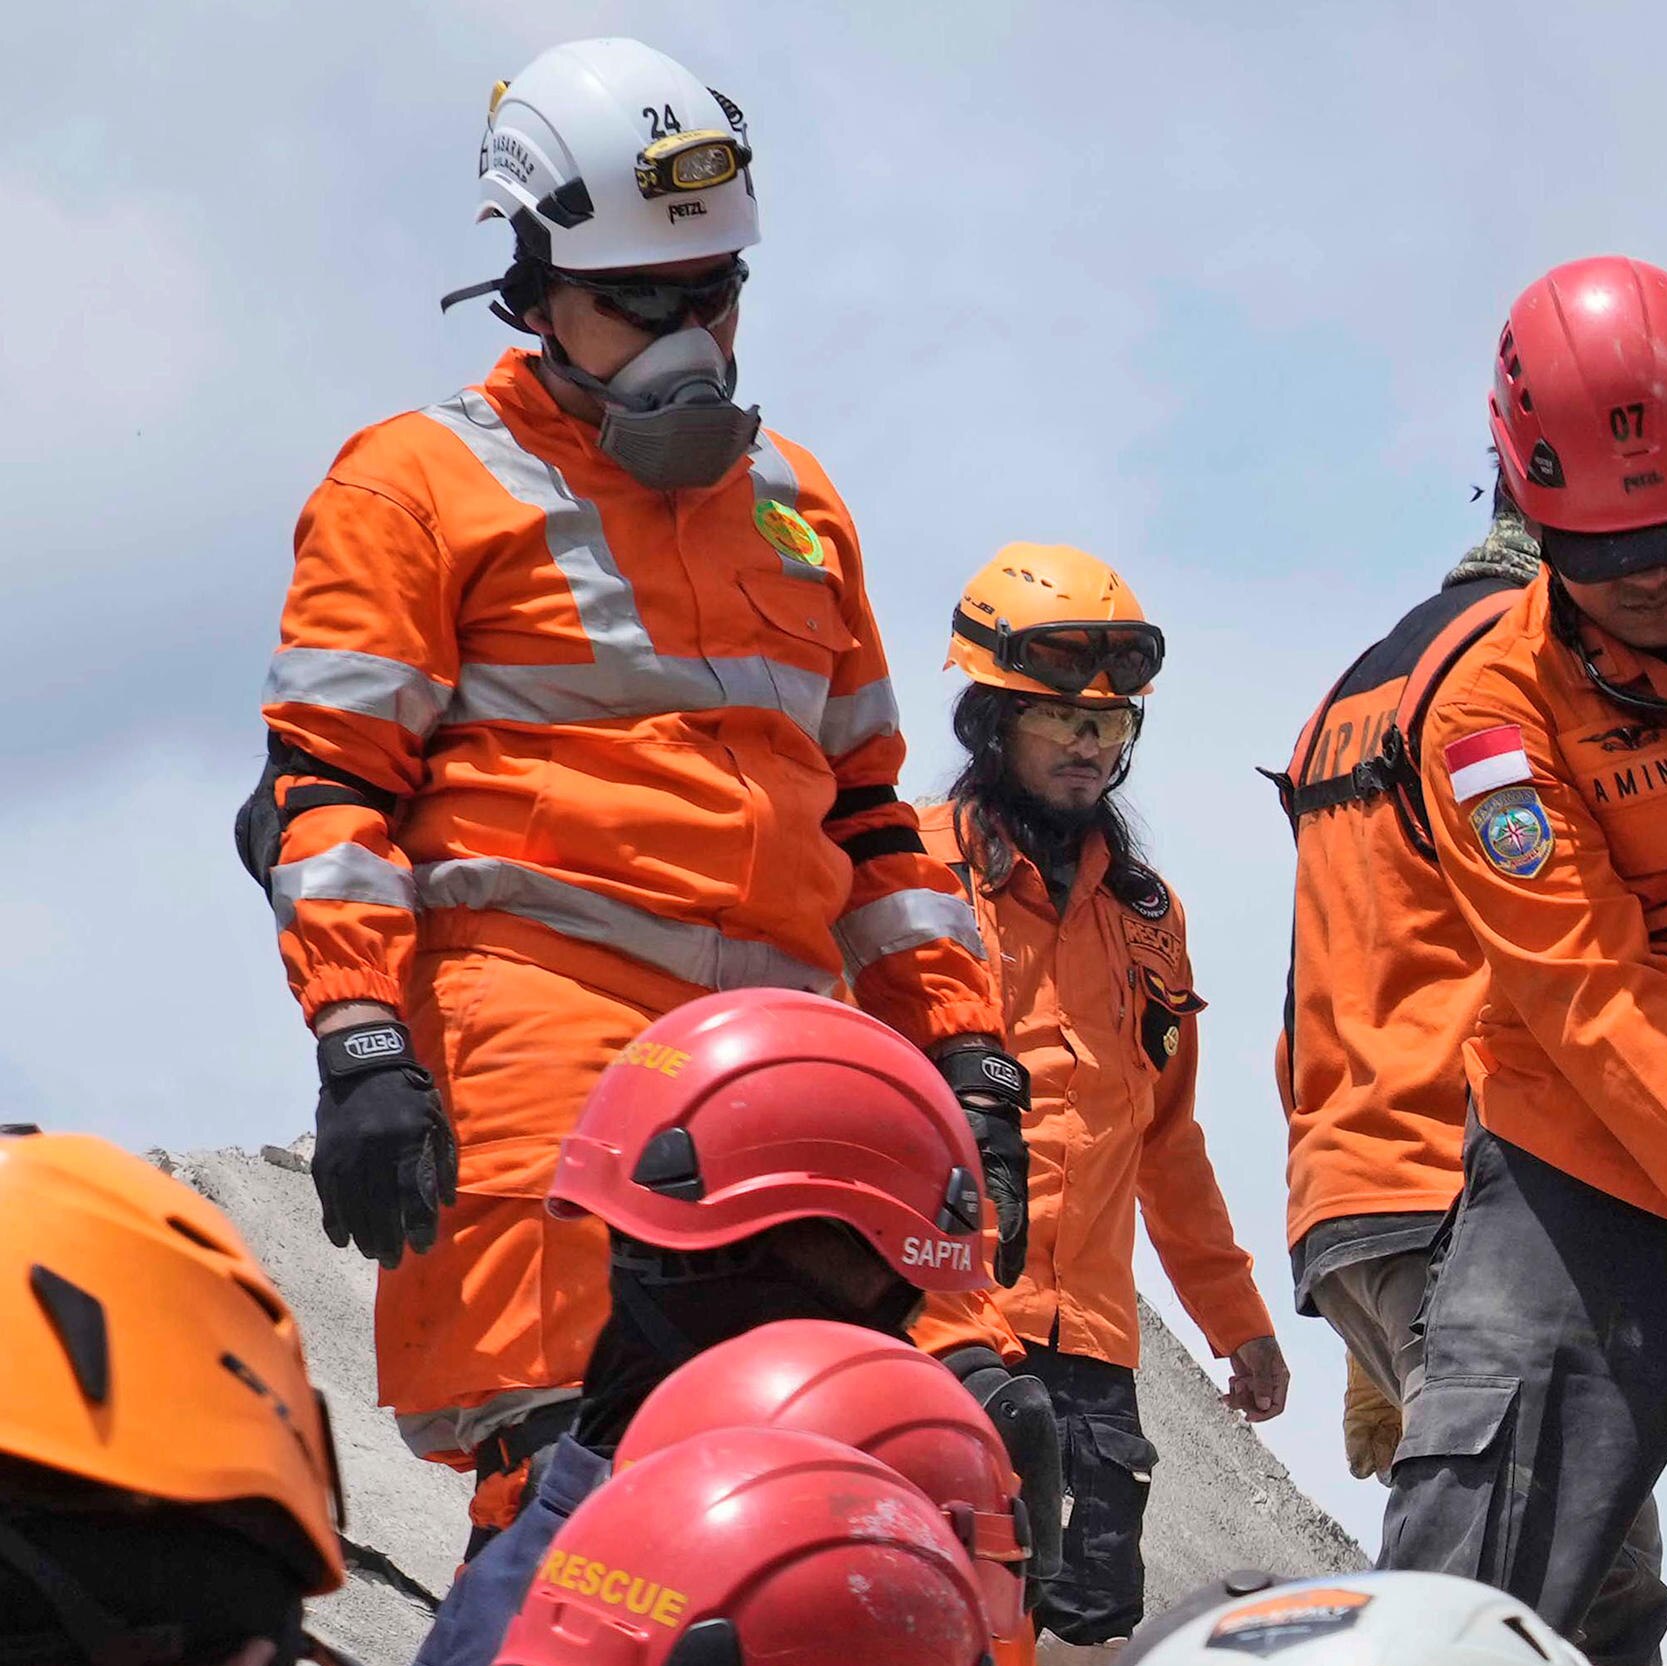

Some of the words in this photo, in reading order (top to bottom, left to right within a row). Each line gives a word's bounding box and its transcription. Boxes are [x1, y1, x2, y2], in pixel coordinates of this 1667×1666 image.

[642, 104, 682, 139] 24
[668, 201, 708, 225] PETZL
[1609, 402, 1645, 442] 07
[344, 1027, 404, 1058] PETZL
[901, 1236, 973, 1271] SAPTA
[539, 1549, 689, 1628] RESCUE
